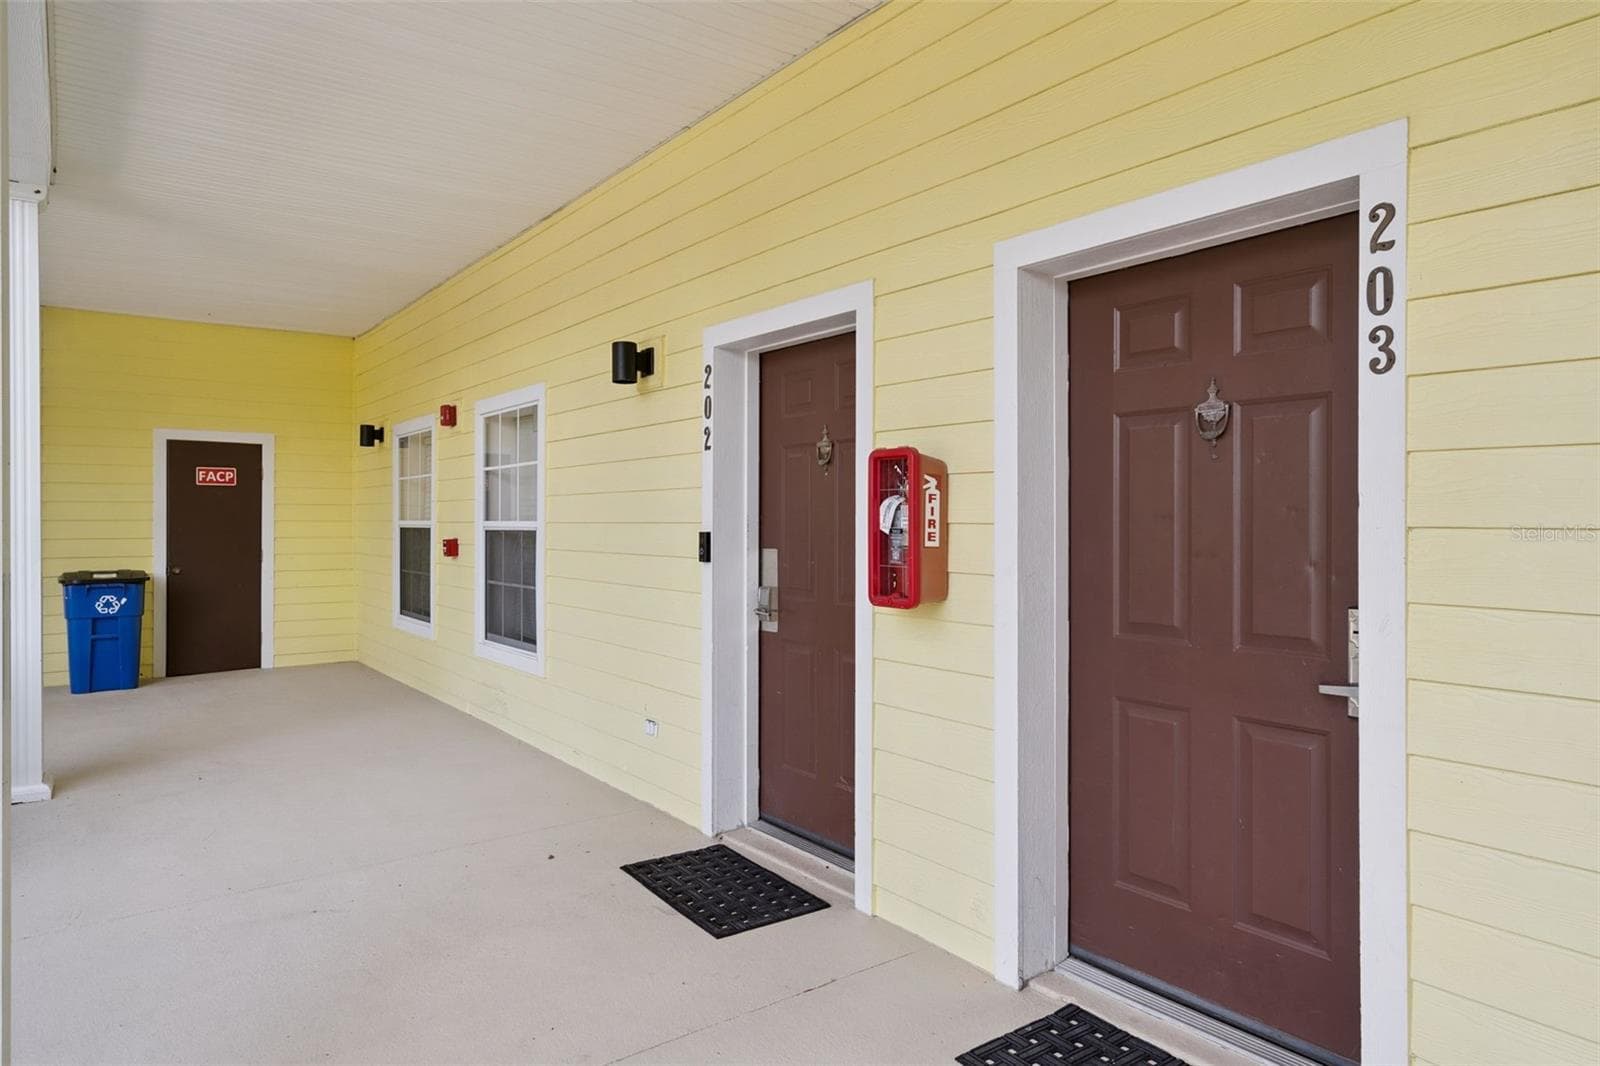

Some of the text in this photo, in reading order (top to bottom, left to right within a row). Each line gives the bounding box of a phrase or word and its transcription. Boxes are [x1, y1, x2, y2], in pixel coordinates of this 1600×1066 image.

[1366, 202, 1396, 375] 203
[703, 364, 713, 452] 202
[198, 470, 234, 483] FACP
[926, 493, 938, 543] FIRE
